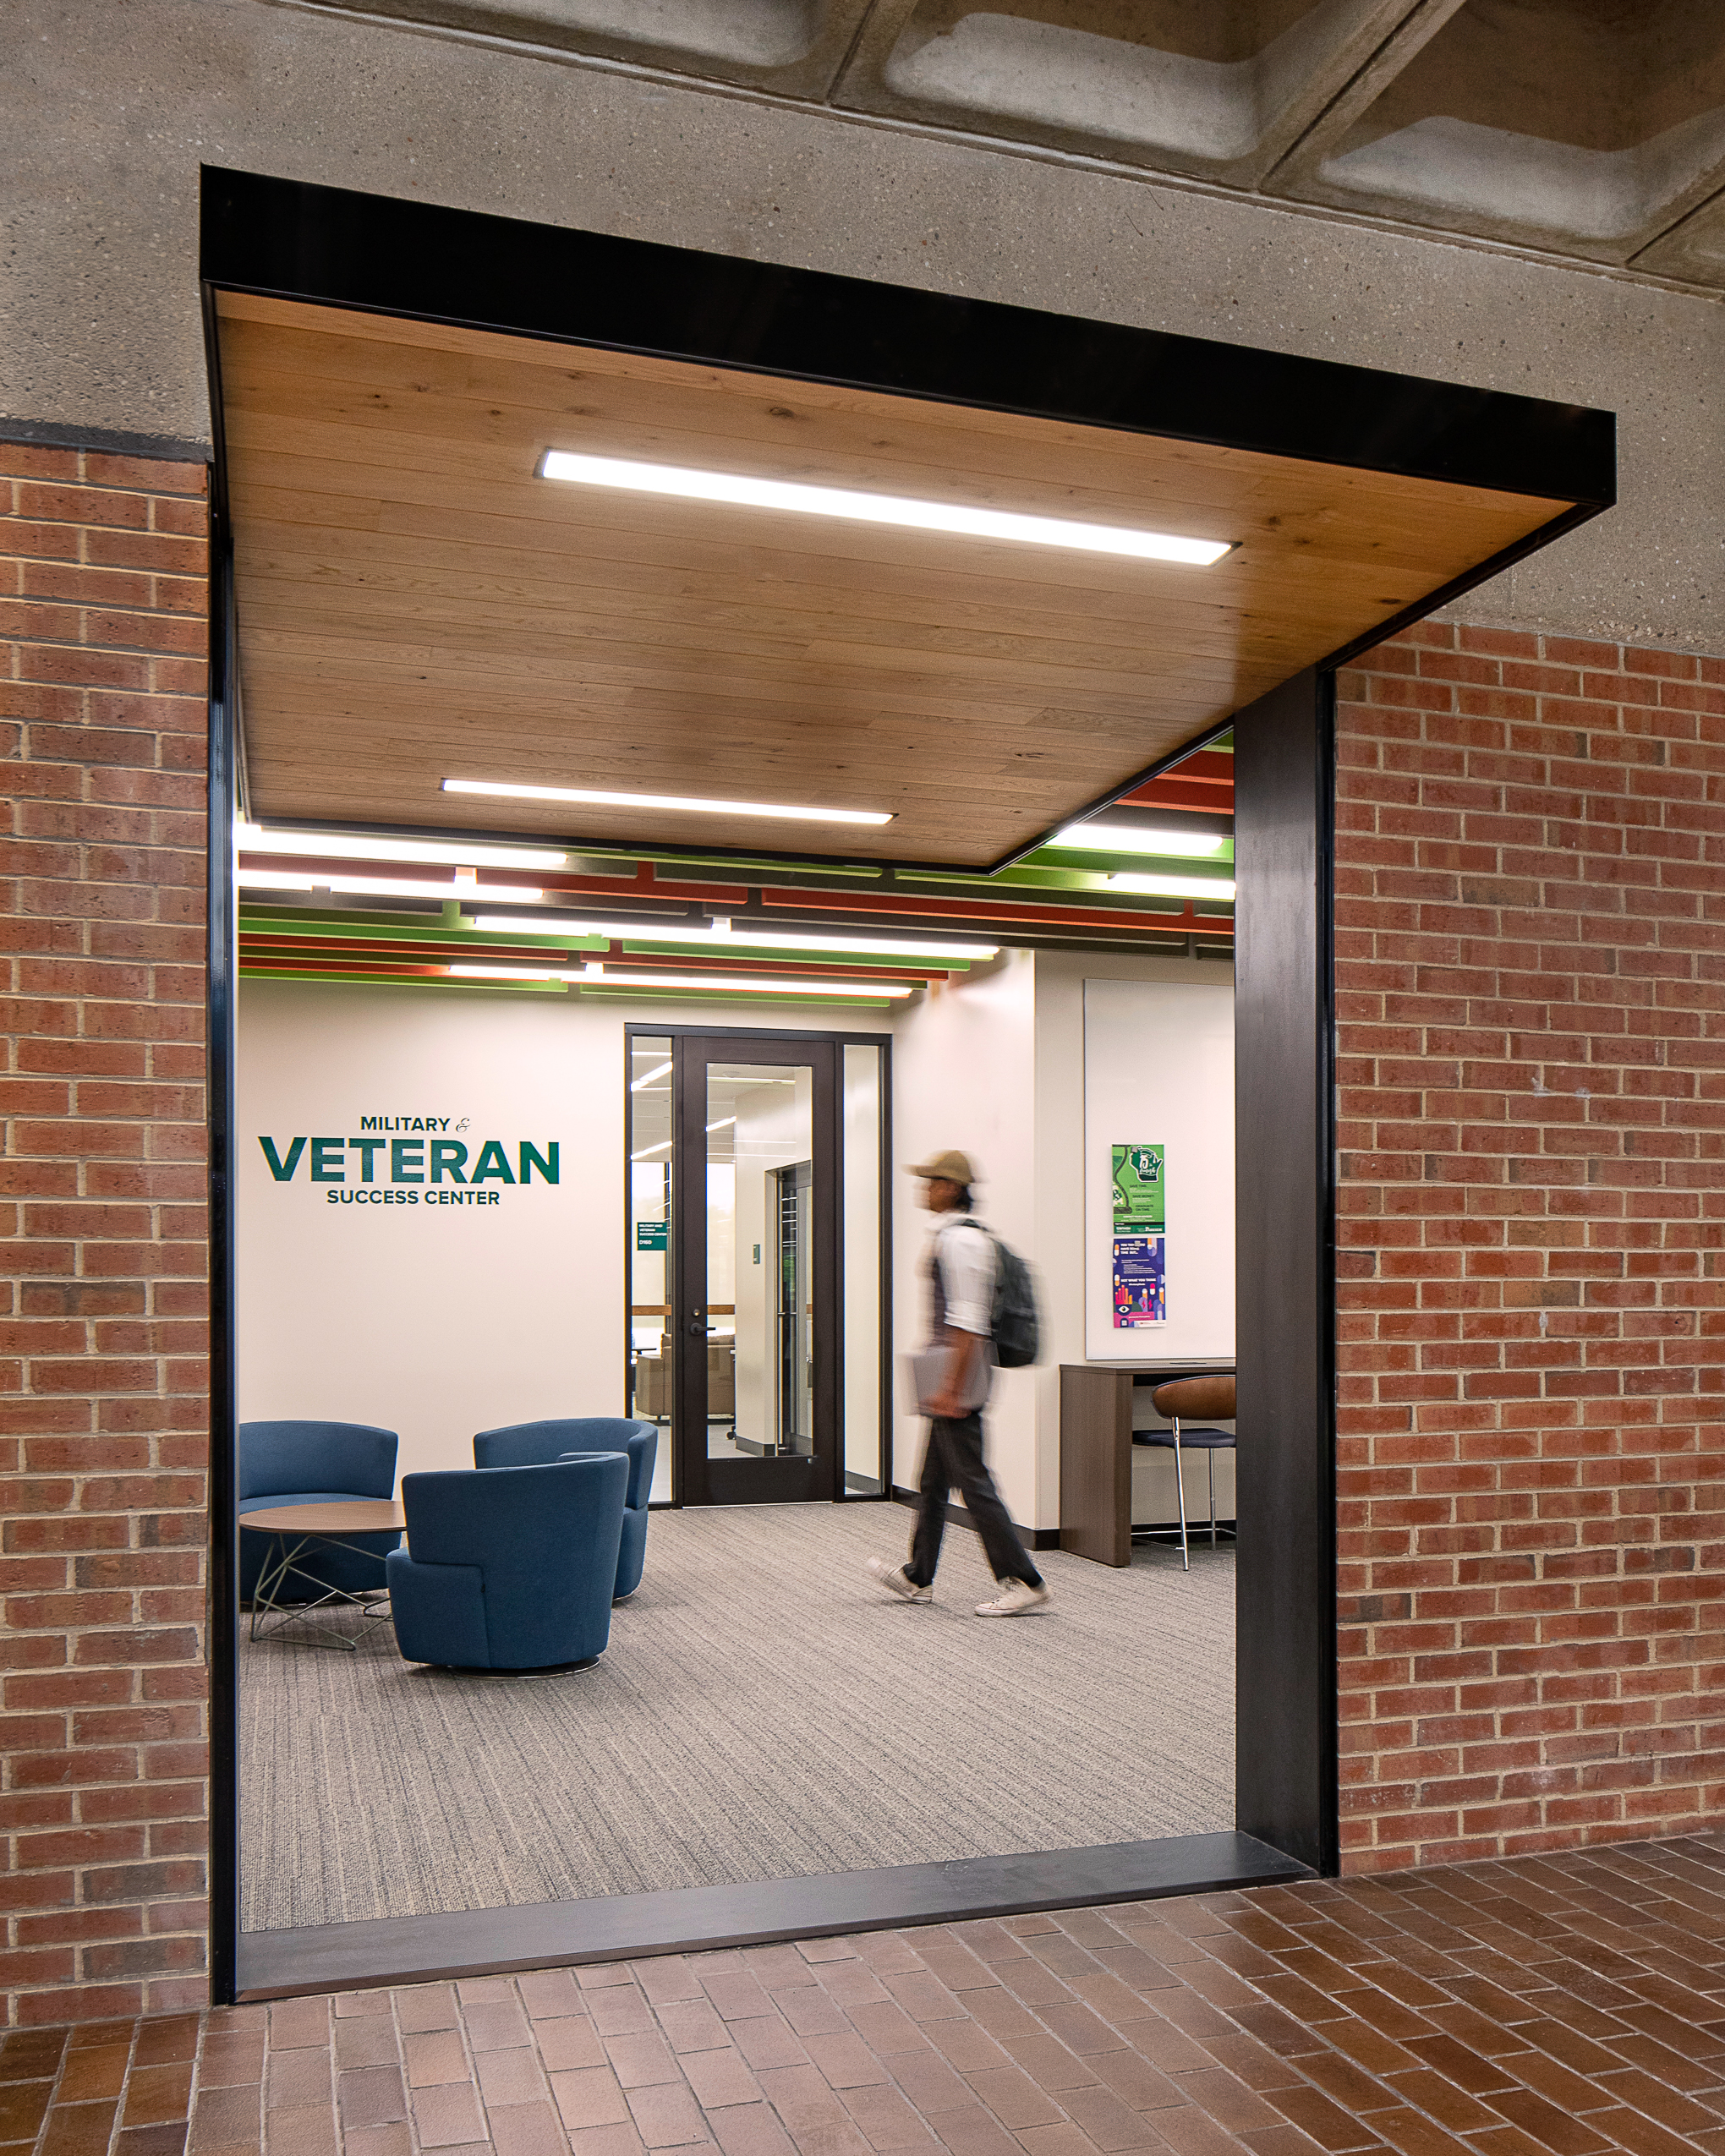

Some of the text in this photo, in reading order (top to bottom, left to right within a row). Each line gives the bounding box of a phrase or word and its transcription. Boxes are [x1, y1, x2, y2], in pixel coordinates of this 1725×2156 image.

[360, 1116, 471, 1133] MILITARY &
[257, 1135, 560, 1185] VETERAN
[326, 1190, 500, 1205] SUCCESS CENTER
